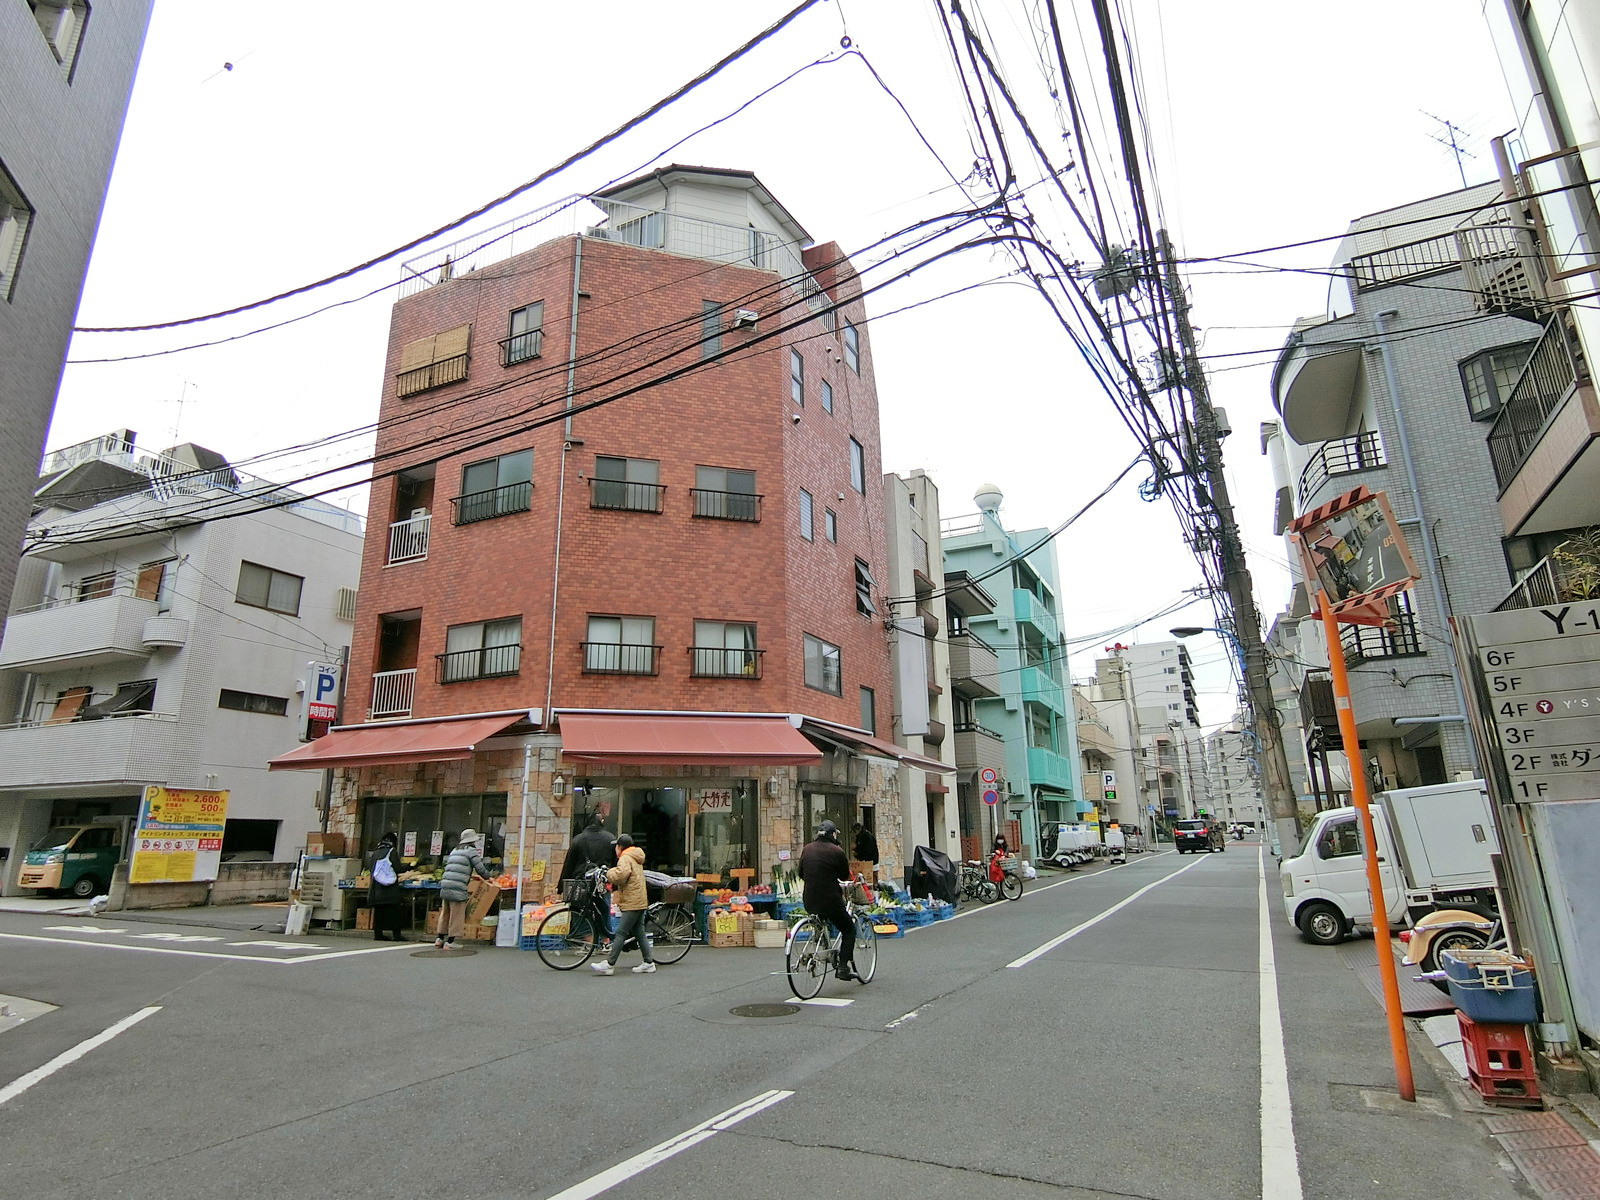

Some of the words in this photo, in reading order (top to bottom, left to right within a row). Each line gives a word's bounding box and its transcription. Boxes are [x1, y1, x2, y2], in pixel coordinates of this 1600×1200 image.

[1487, 651, 1515, 666] 6F
[318, 665, 338, 674] コイン
[316, 673, 335, 701] P
[1493, 676, 1521, 692] 5F
[310, 705, 336, 719] 時間貸
[1500, 702, 1528, 717] 4F
[1505, 728, 1534, 743] 3F
[1511, 754, 1541, 770] 2F
[985, 772, 993, 780] 30
[1105, 775, 1113, 785] P
[1517, 781, 1548, 797] 1F
[701, 790, 731, 809] 大特売
